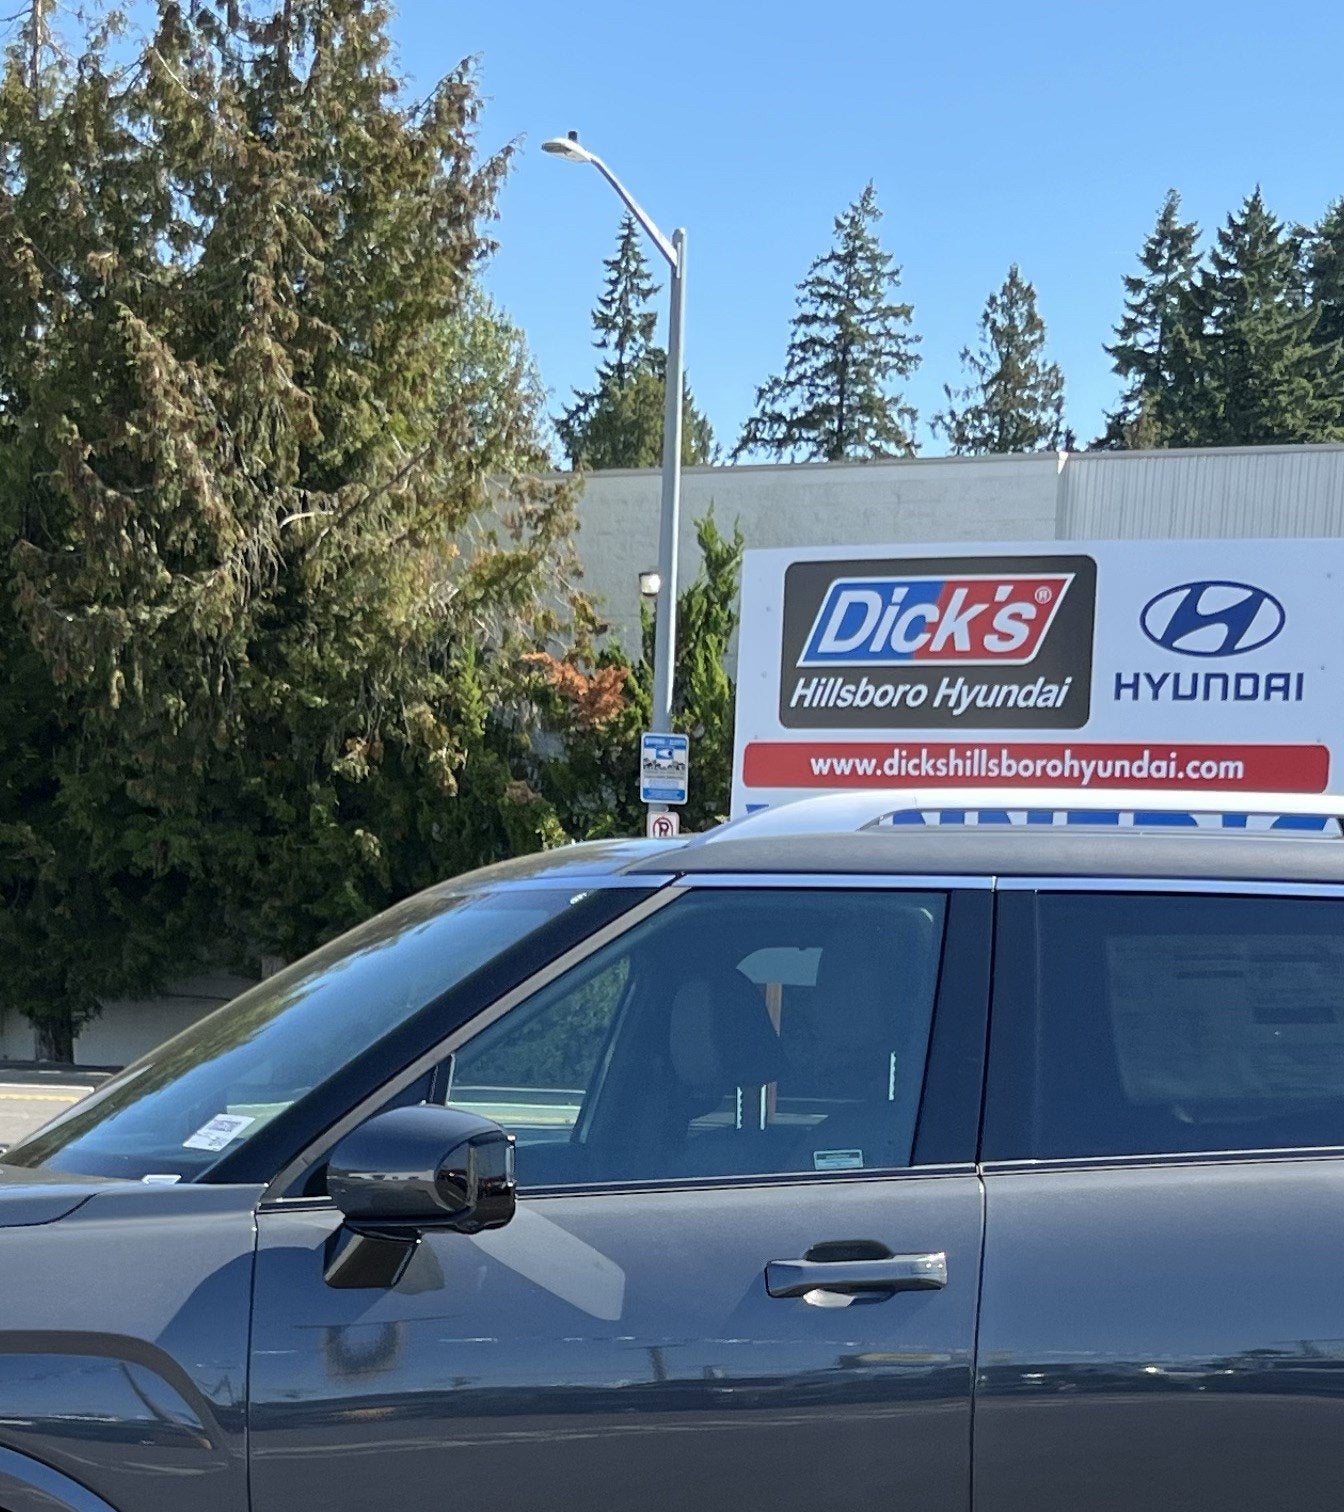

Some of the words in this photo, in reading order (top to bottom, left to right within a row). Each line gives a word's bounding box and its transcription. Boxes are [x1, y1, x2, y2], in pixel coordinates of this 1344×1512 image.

[817, 585, 1037, 653] Dick's
[789, 676, 928, 708] Hillsboro
[932, 675, 1073, 716] Hyundai
[1114, 672, 1304, 701] HYUNDAI
[810, 747, 1245, 787] www.dickshillsborohyundai.com
